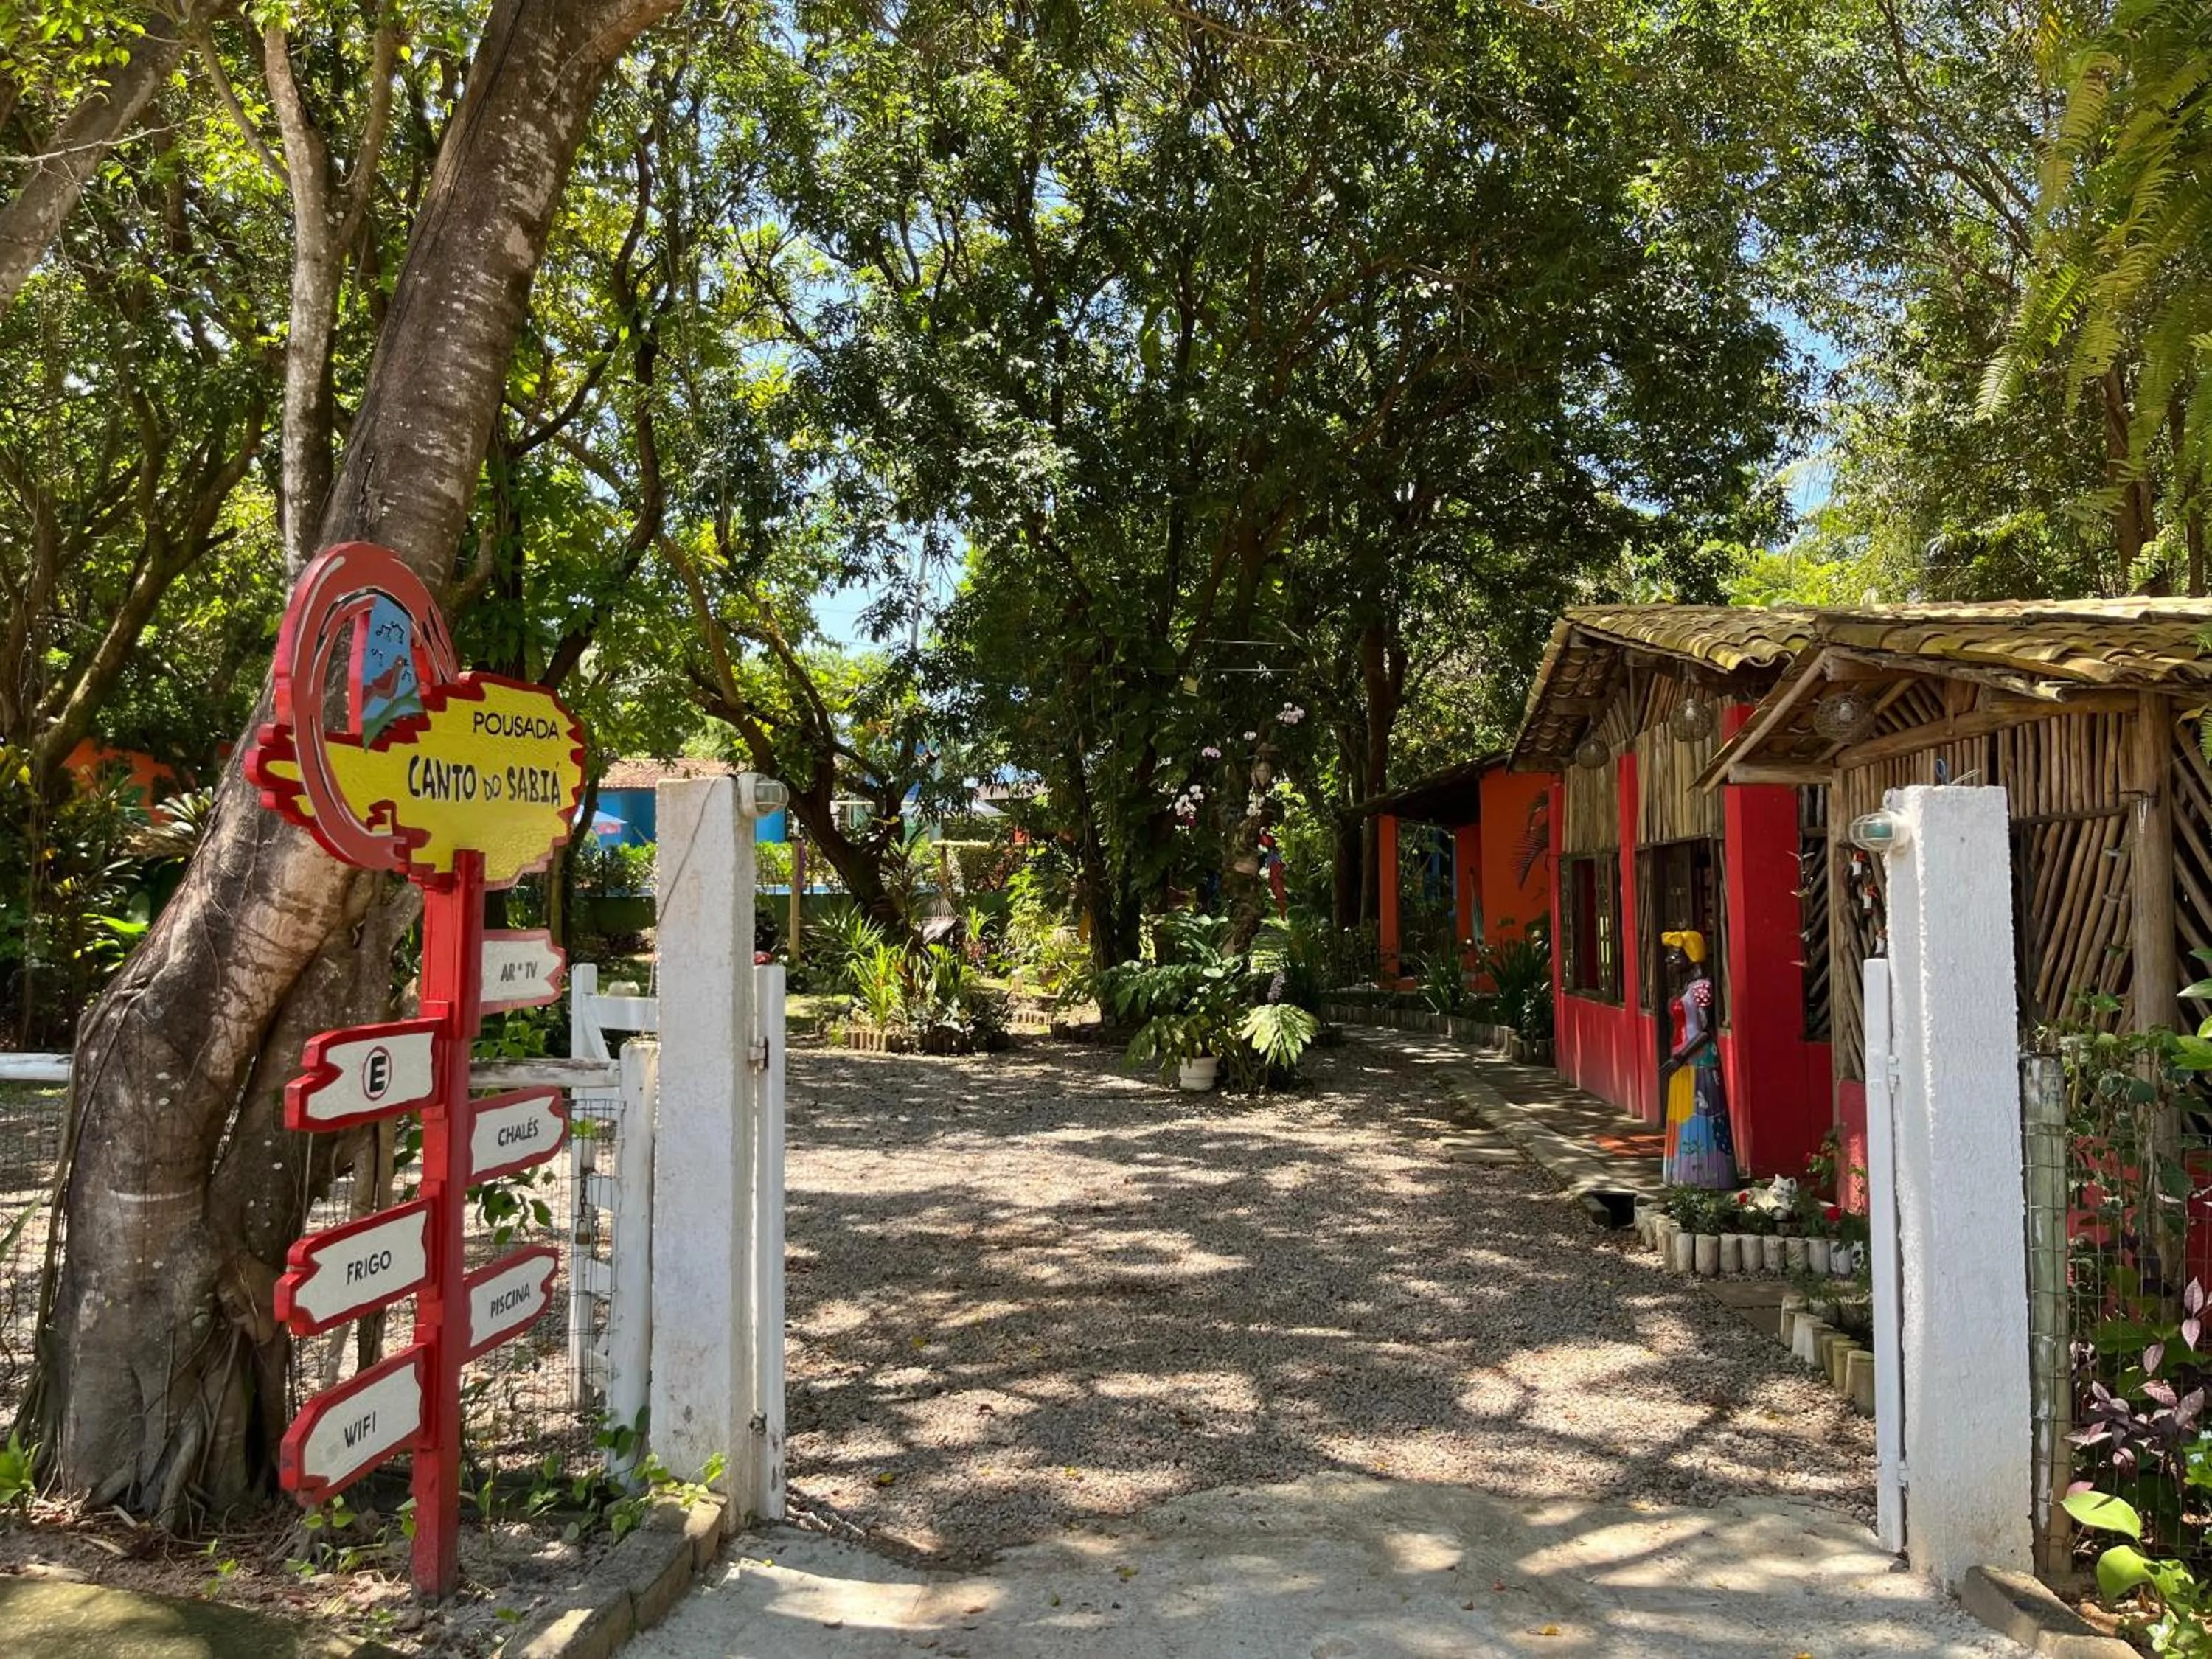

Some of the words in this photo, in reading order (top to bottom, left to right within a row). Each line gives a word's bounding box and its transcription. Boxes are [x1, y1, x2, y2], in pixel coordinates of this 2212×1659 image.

[473, 712, 559, 740] POUSADA
[408, 754, 477, 801] CANTO
[483, 774, 502, 801] DO
[507, 761, 561, 807] SABIÁ
[501, 963, 515, 981] AR
[526, 961, 538, 979] TV
[369, 1055, 386, 1093] E
[498, 1118, 538, 1145] CHALÉS
[347, 1250, 392, 1284] FRIGO
[490, 1283, 530, 1318] PISCINA
[344, 1411, 376, 1448] WIFI
